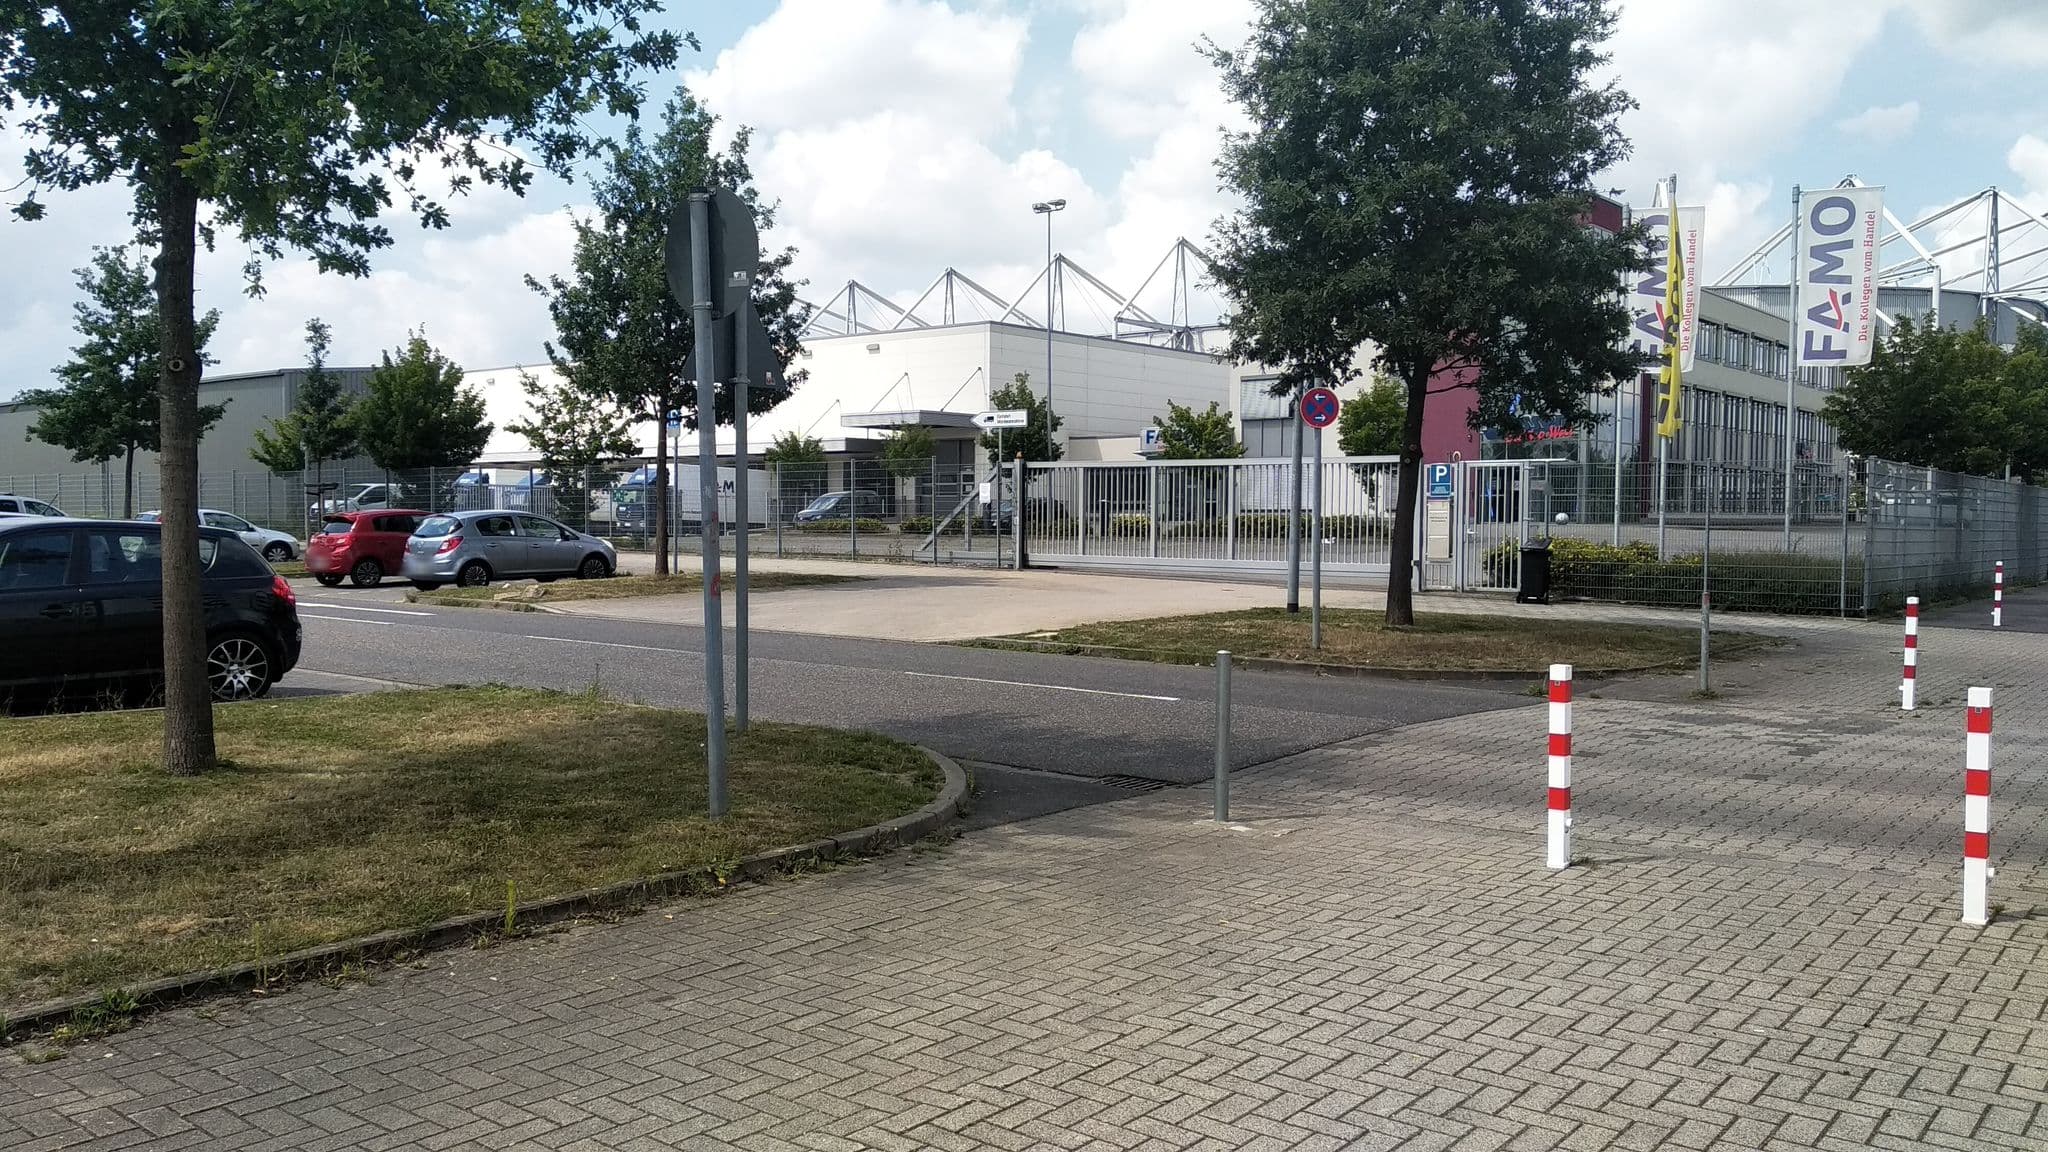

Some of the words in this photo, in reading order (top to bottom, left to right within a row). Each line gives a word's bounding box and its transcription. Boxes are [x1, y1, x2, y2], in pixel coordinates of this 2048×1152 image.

[1863, 210, 1876, 247] Handel
[1687, 229, 1698, 264] Handel
[1863, 251, 1873, 272] vom
[1686, 269, 1696, 289] vom
[1803, 196, 1857, 361] FAMO
[1682, 291, 1695, 334] Kollegen
[1859, 274, 1873, 323] Kollegen
[1681, 335, 1689, 351] Die
[1858, 324, 1868, 342] Die
[1435, 465, 1448, 483] P
